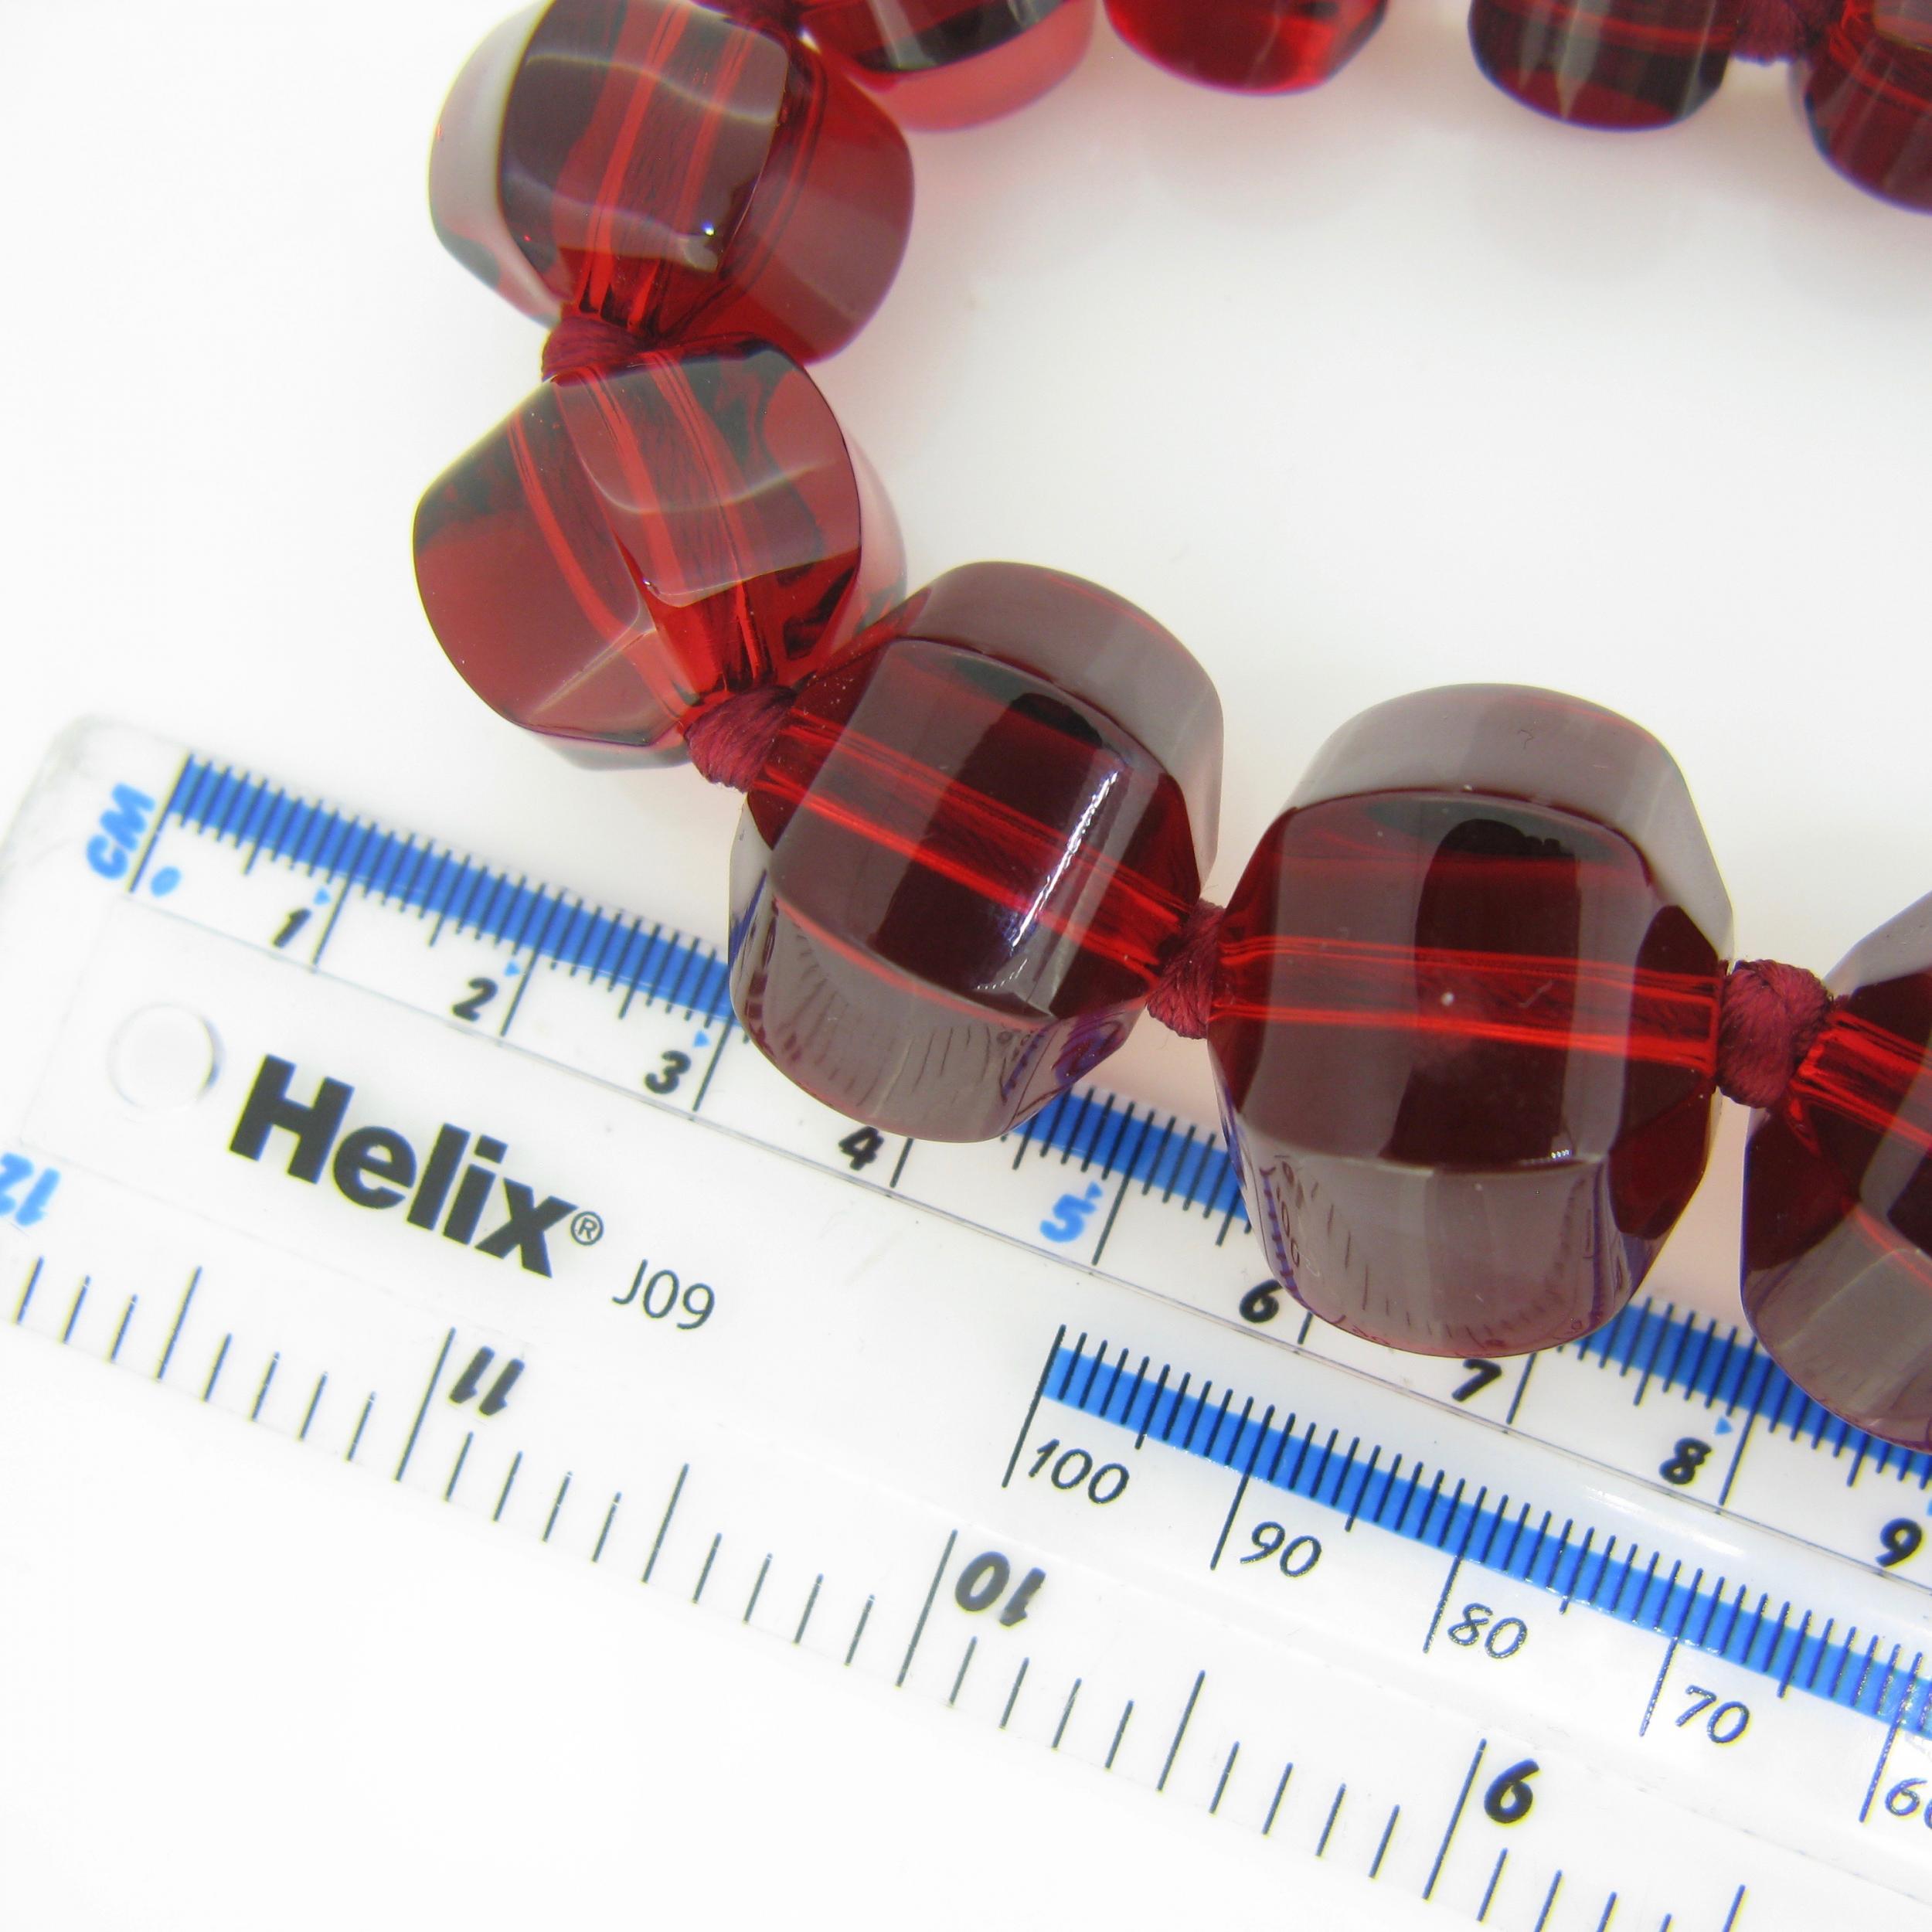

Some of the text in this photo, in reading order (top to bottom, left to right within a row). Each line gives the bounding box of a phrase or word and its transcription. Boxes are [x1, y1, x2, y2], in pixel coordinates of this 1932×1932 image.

[86, 782, 156, 880] CM
[149, 865, 1923, 1566] 0 1 2 3 4 5 6 7 8 9
[611, 1258, 716, 1331] J09
[447, 1345, 526, 1418] 11
[954, 1550, 1046, 1629] 10
[1029, 1438, 1932, 1829] 100 90 80 70 6
